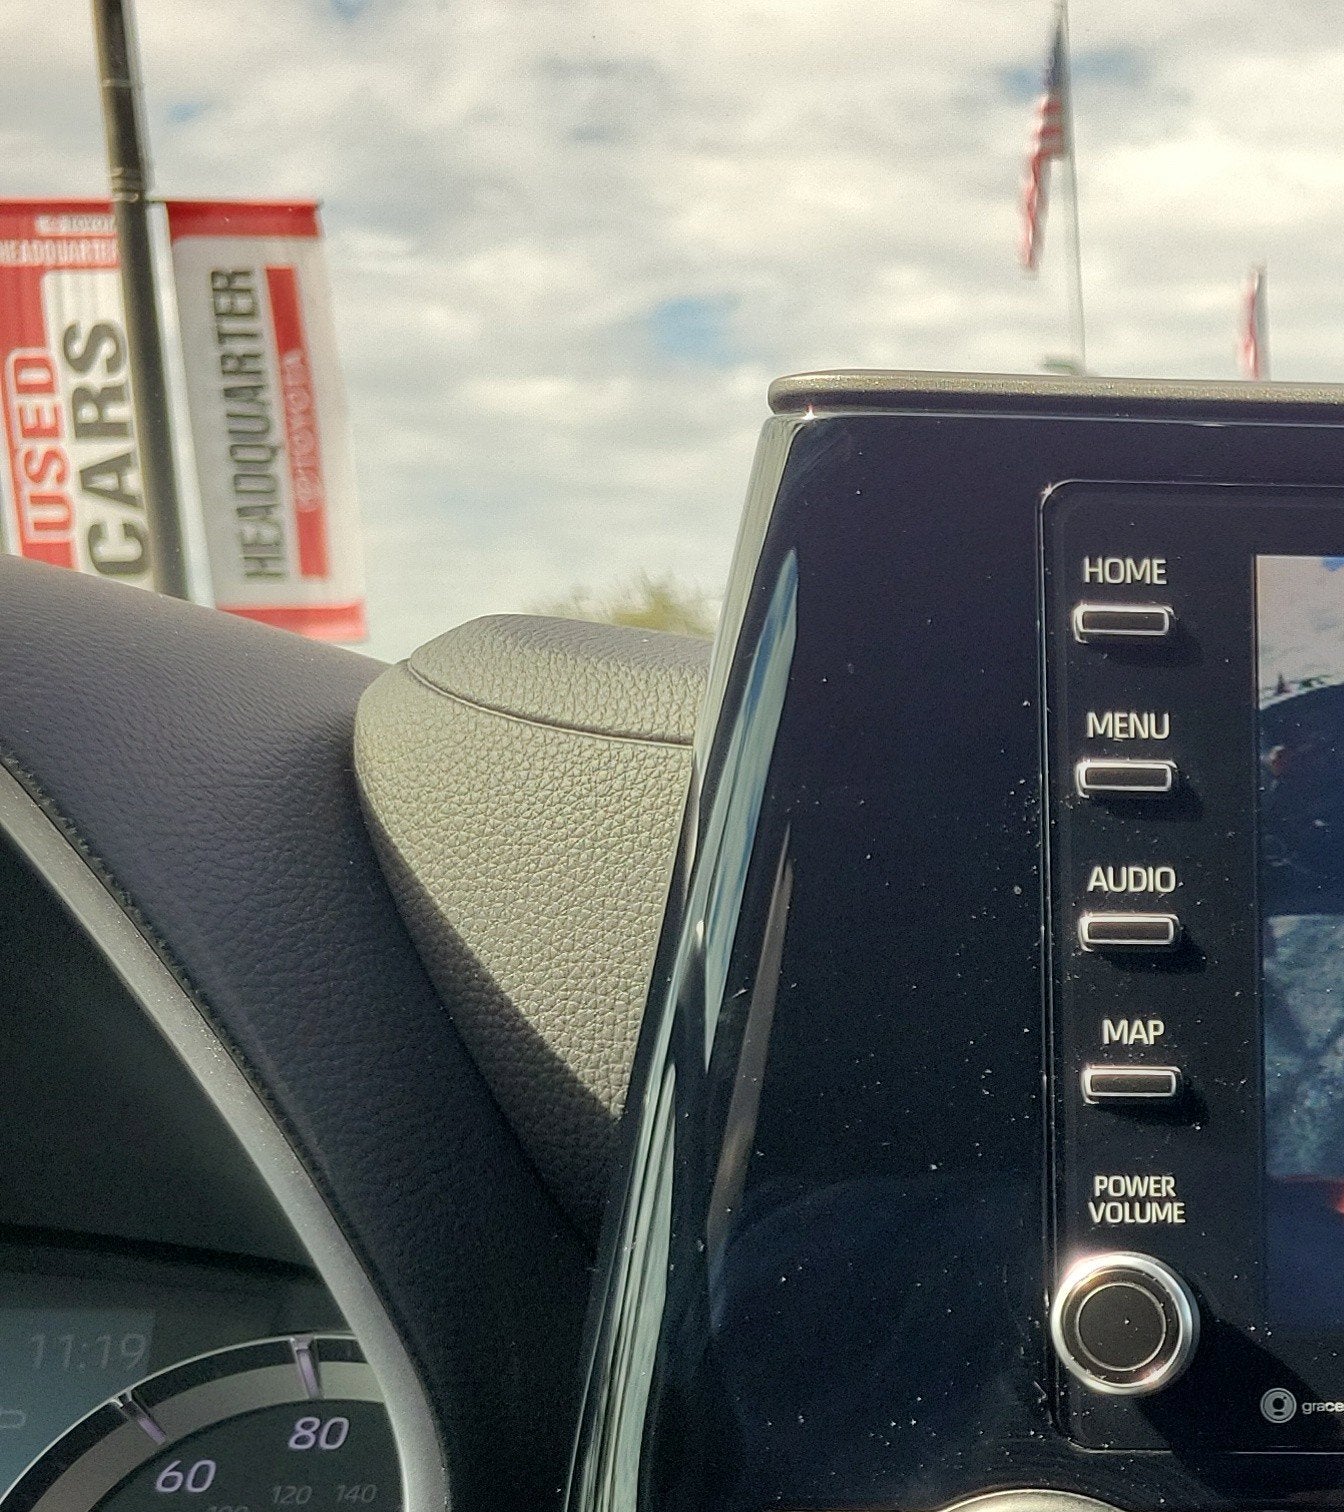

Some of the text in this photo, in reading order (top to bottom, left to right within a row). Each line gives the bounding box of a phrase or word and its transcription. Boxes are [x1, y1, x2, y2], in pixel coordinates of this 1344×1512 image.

[211, 267, 289, 580] HEADQUARTER
[14, 354, 73, 533] USED
[63, 322, 152, 577] CARS
[1083, 555, 1167, 585] HOME
[1086, 711, 1171, 740] MENU
[1087, 866, 1176, 893] AUDIO
[1102, 1019, 1165, 1046] MAP
[1093, 1174, 1176, 1198] POWER
[1088, 1201, 1186, 1224] VOLUME
[29, 1333, 146, 1371] 11:19
[288, 1416, 350, 1451] 80
[155, 1459, 216, 1494] 60
[273, 1484, 376, 1505] 120 140
